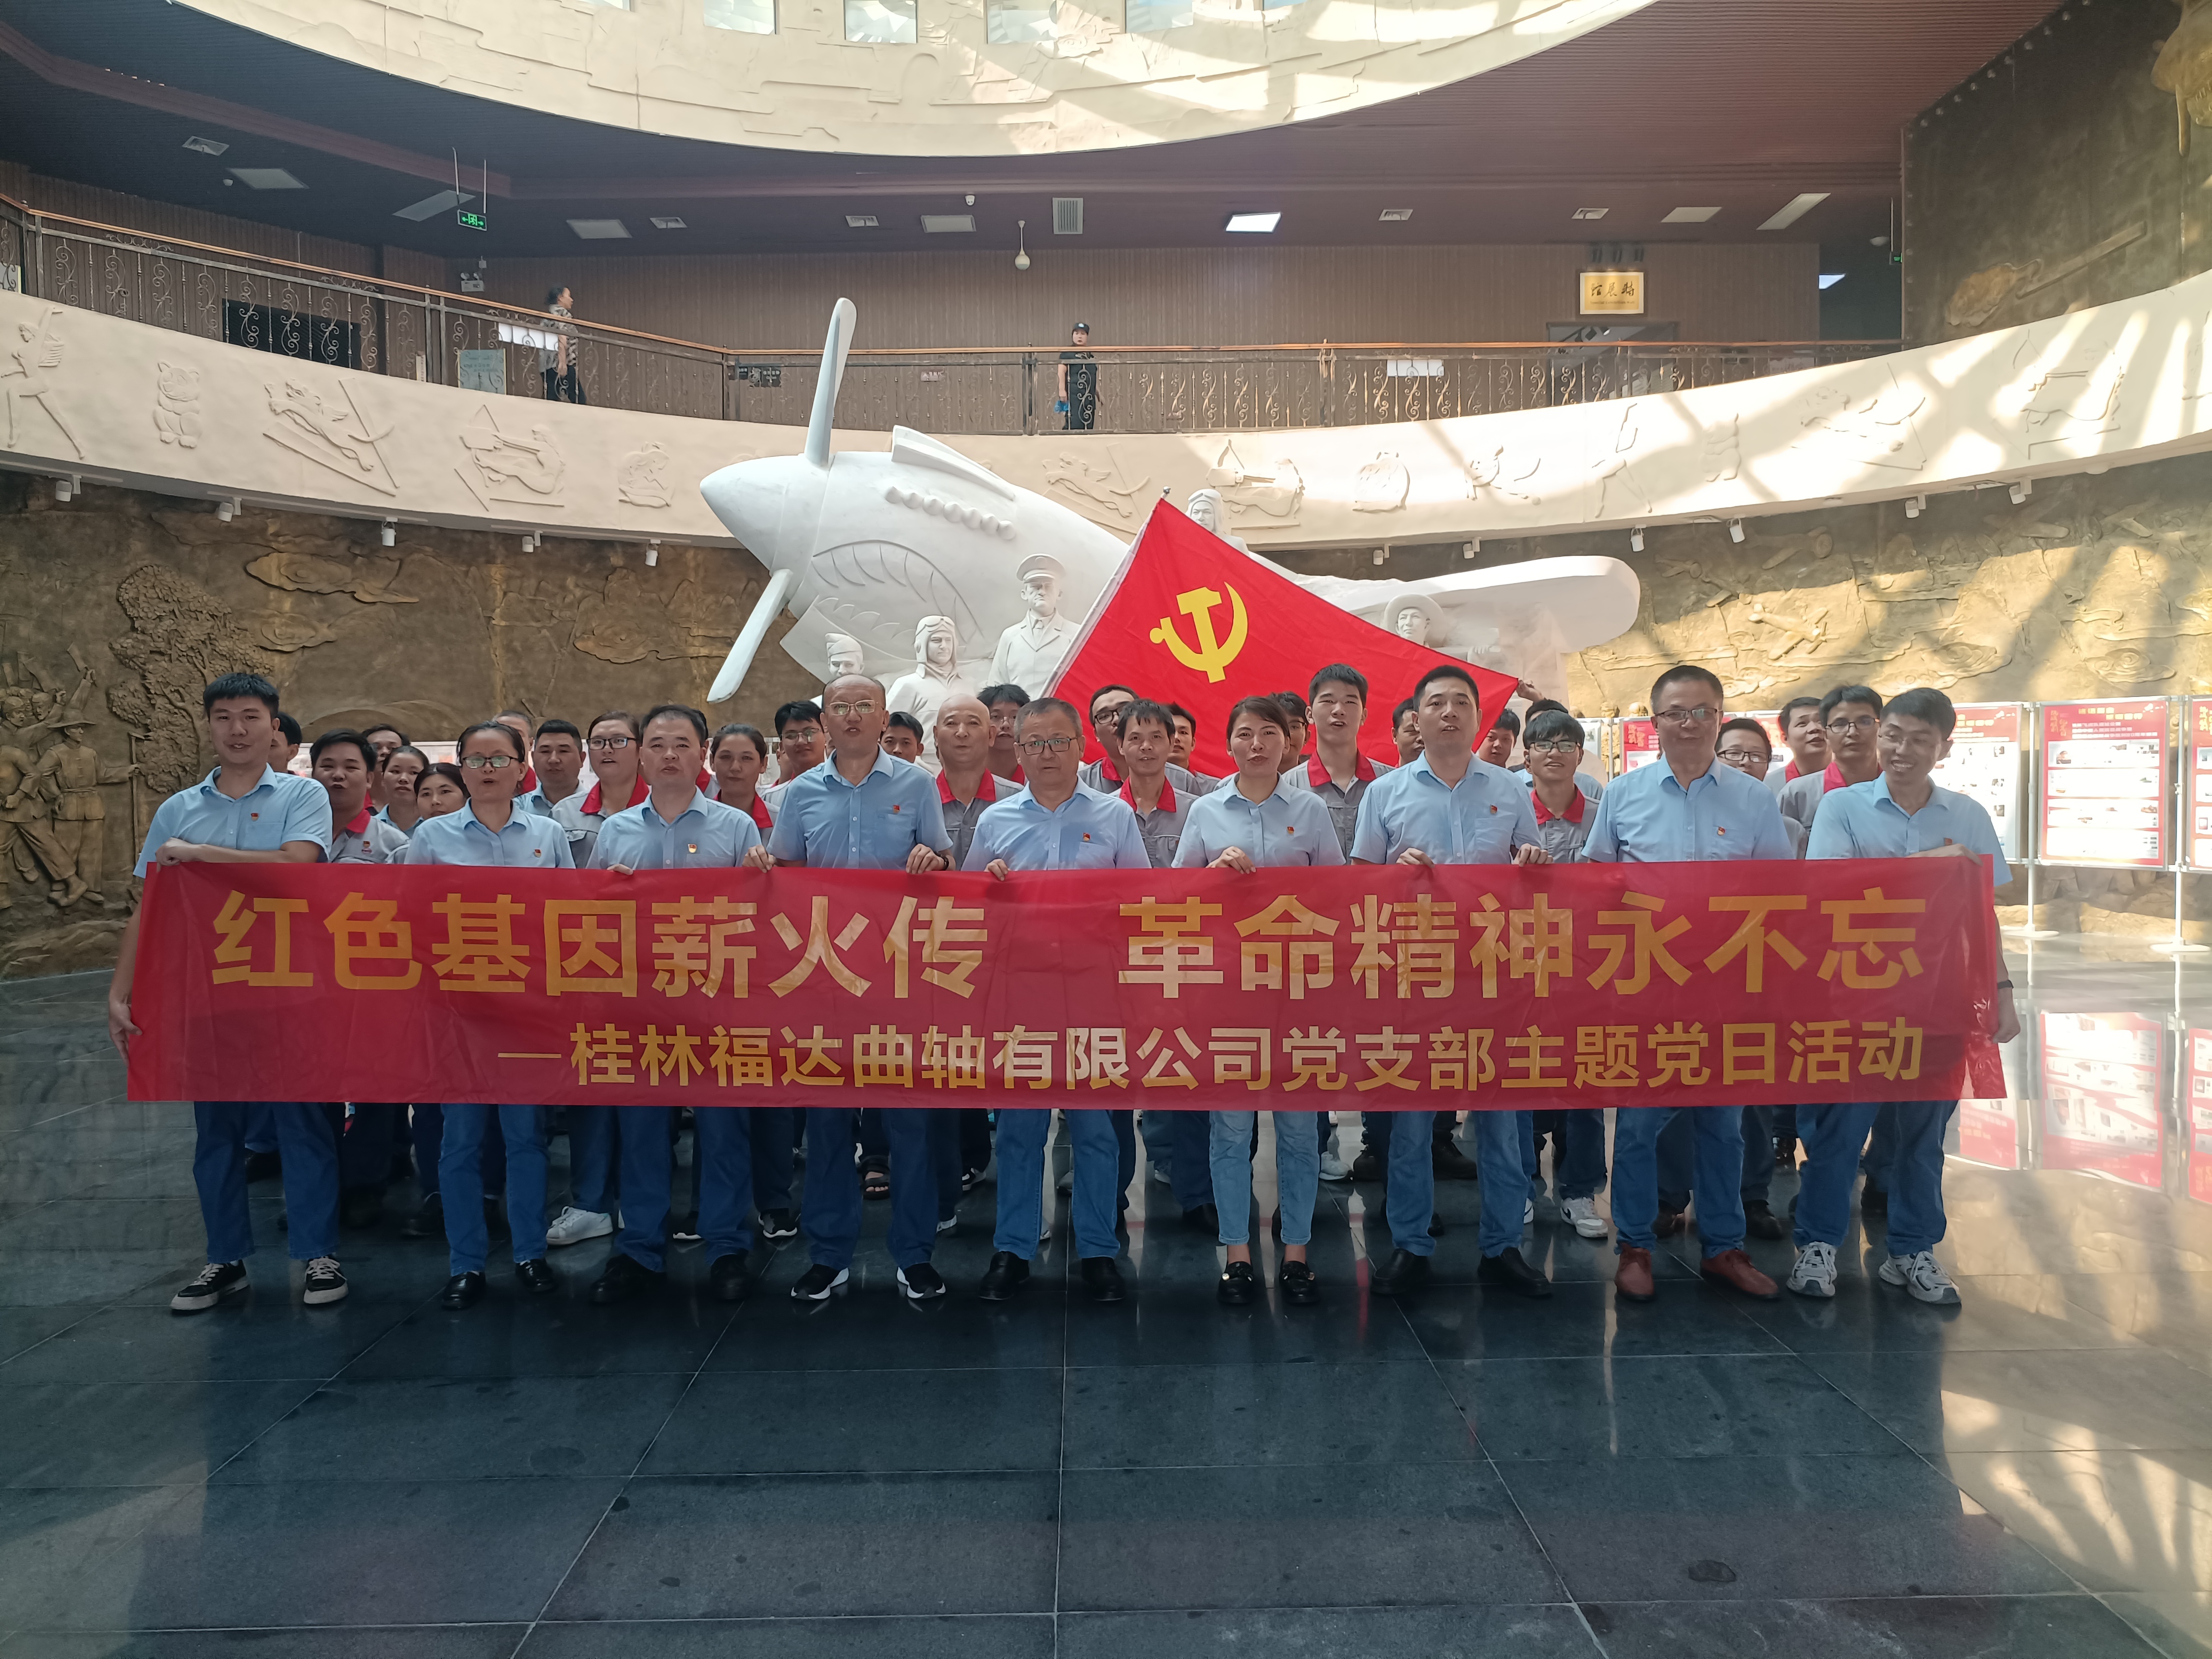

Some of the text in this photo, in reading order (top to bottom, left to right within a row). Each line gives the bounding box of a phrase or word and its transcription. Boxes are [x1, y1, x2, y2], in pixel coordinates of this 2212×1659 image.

[212, 887, 1925, 999] 红色基因薪火传 革命精神永不忘
